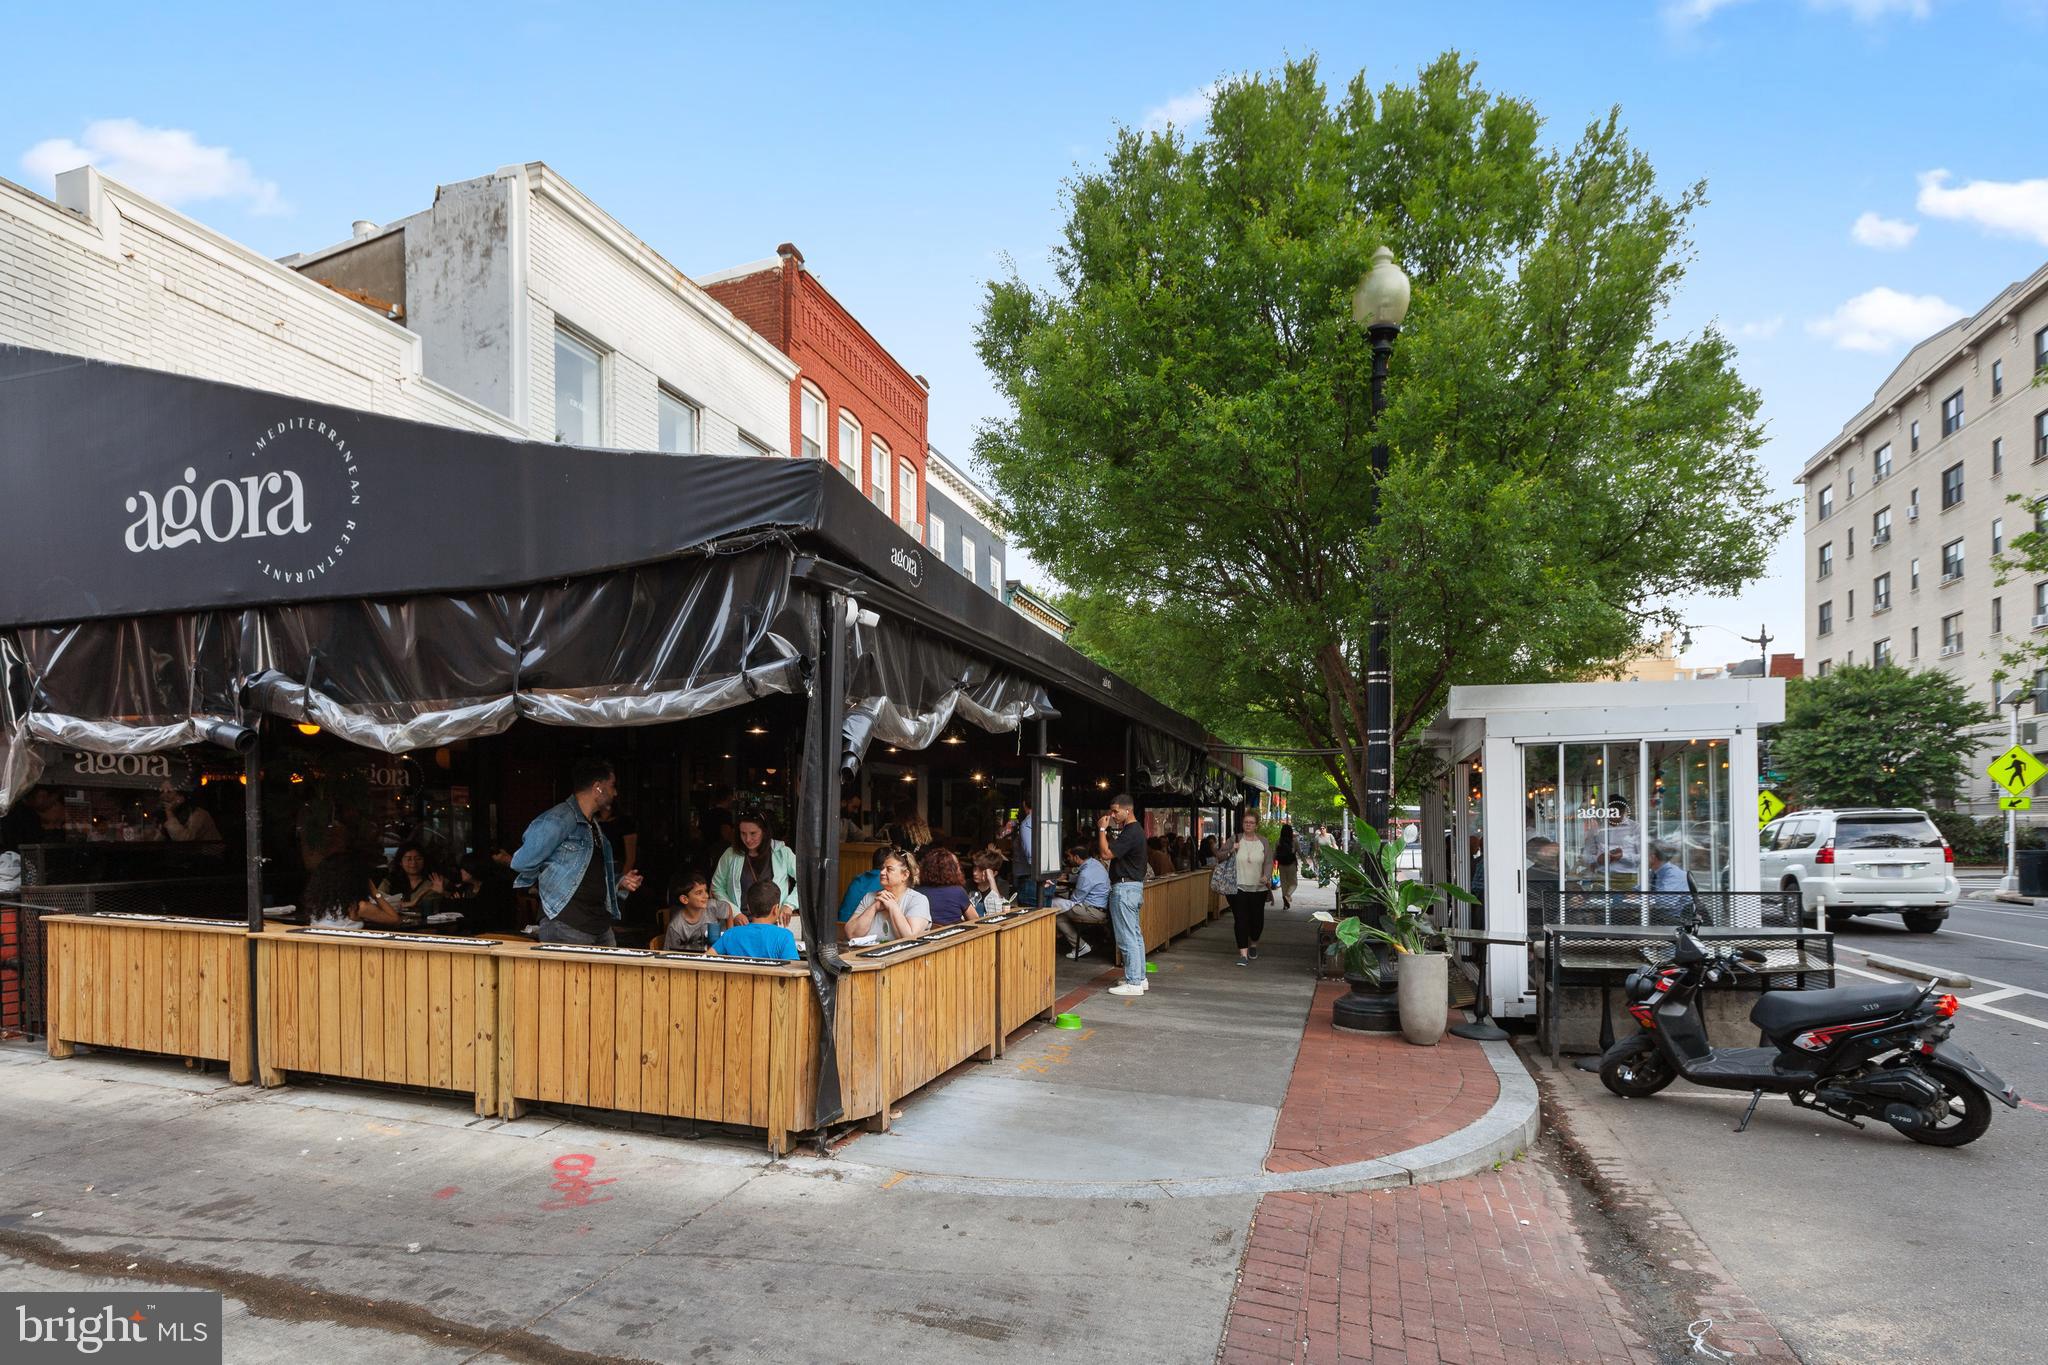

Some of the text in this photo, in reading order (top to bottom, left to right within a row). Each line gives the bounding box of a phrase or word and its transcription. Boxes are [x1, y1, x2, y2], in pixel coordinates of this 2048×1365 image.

[125, 467, 312, 553] agora
[256, 417, 360, 583] MEDITERRANEAN RESTAURANT
[891, 548, 917, 577] agora
[74, 752, 171, 777] agora
[1577, 806, 1621, 819] agora
[1862, 1003, 1880, 1012] X19
